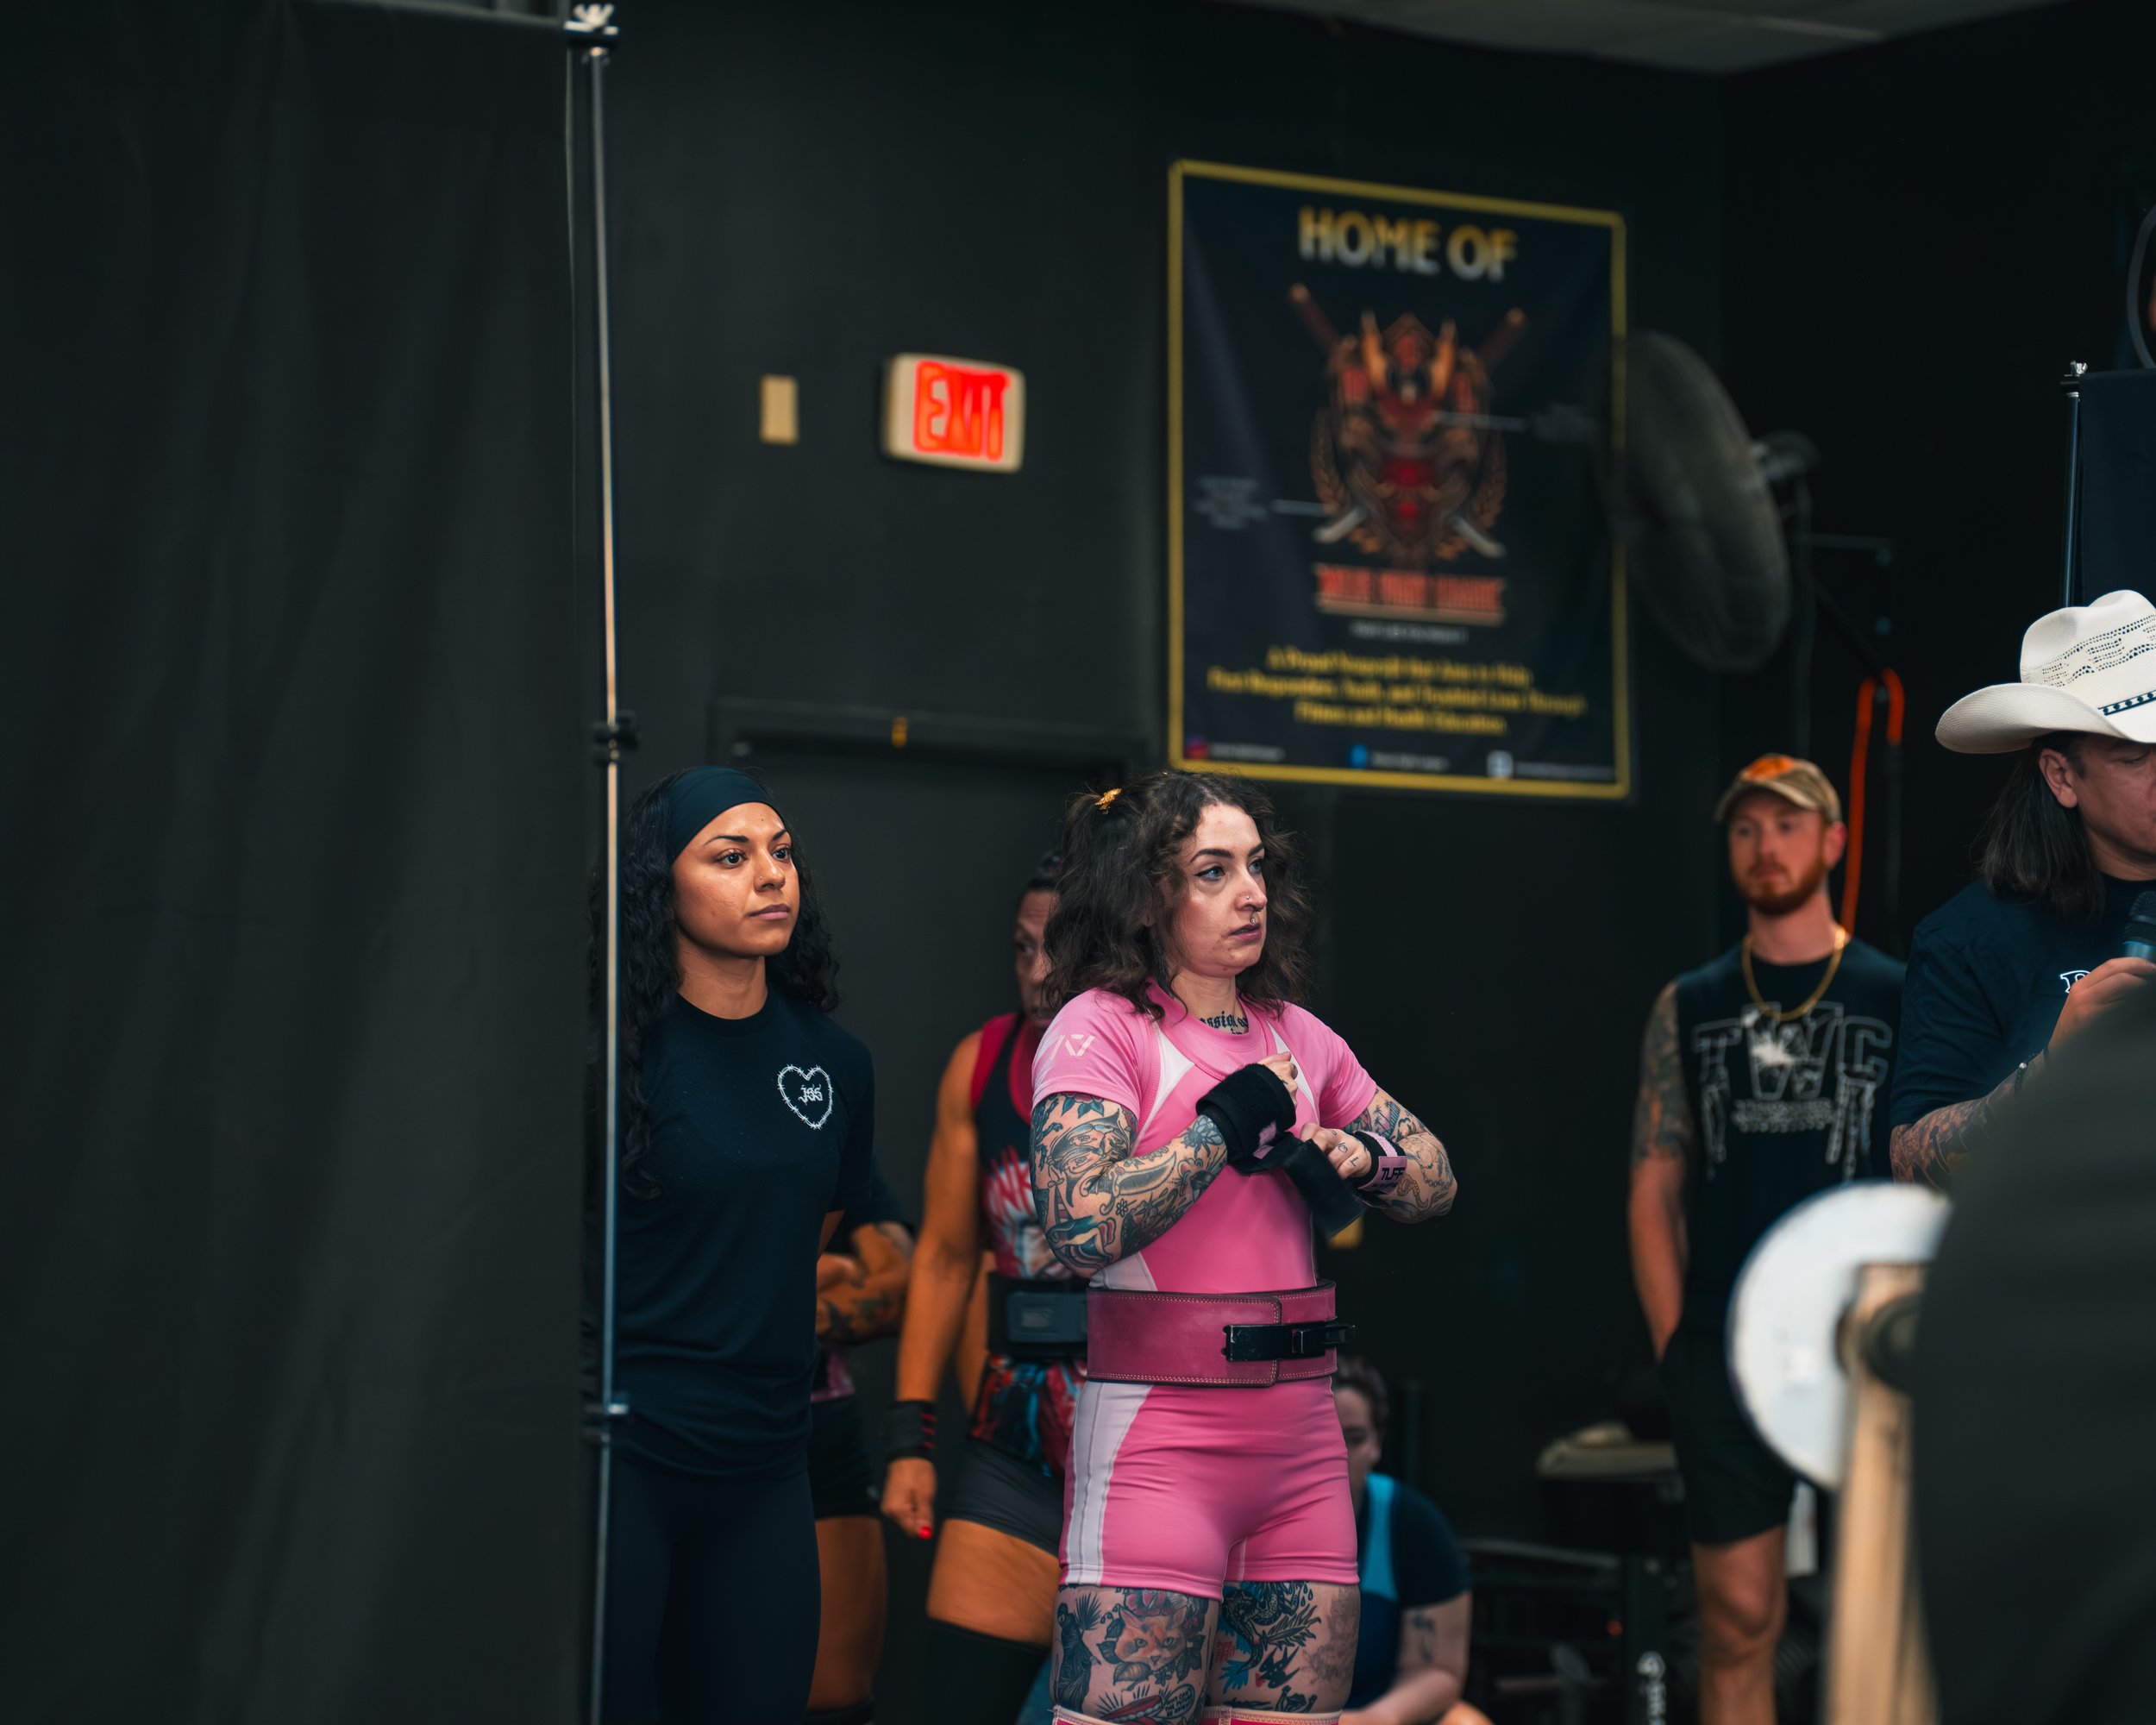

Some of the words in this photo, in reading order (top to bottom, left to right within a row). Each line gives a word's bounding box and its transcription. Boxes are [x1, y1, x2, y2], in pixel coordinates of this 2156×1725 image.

[1298, 206, 1440, 275] HOME
[1447, 224, 1518, 282] OF
[913, 360, 1012, 461] EXIT
